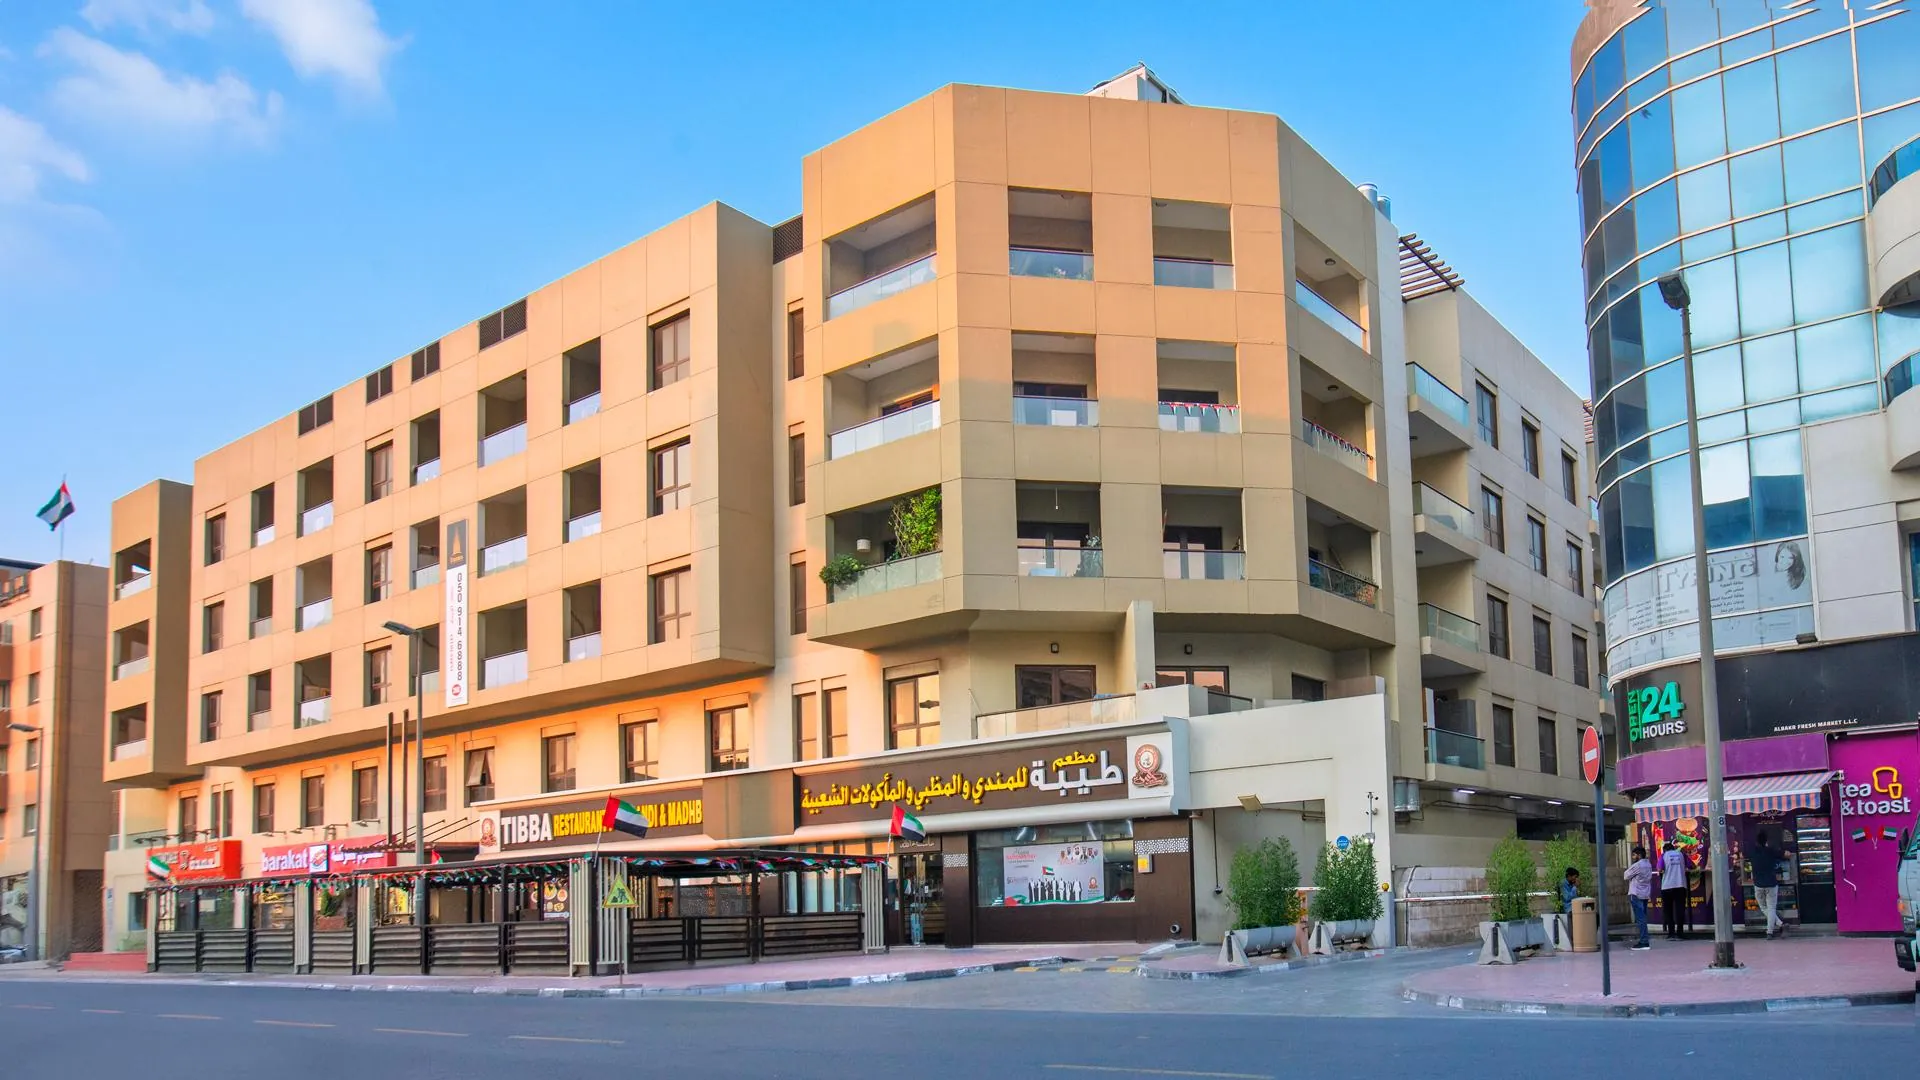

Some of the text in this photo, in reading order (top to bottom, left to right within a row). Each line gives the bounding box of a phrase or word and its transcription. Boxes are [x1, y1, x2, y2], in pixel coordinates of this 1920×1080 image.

[1628, 690, 1639, 742] OPEN
[1641, 681, 1685, 724] 24
[1642, 721, 1686, 739] HOURS
[1797, 722, 1817, 730] FRESH
[1818, 719, 1842, 727] MARKET
[1030, 750, 1125, 797] طيبة
[1052, 751, 1097, 772] مطعم
[801, 783, 850, 815] الشعبية
[972, 766, 1029, 805] للمندي
[1839, 783, 1872, 798] tea
[1841, 797, 1911, 816] & toast
[500, 813, 553, 845] TIBBA
[659, 802, 668, 827] &
[668, 799, 703, 826] MADHB
[261, 847, 309, 872] barakat
